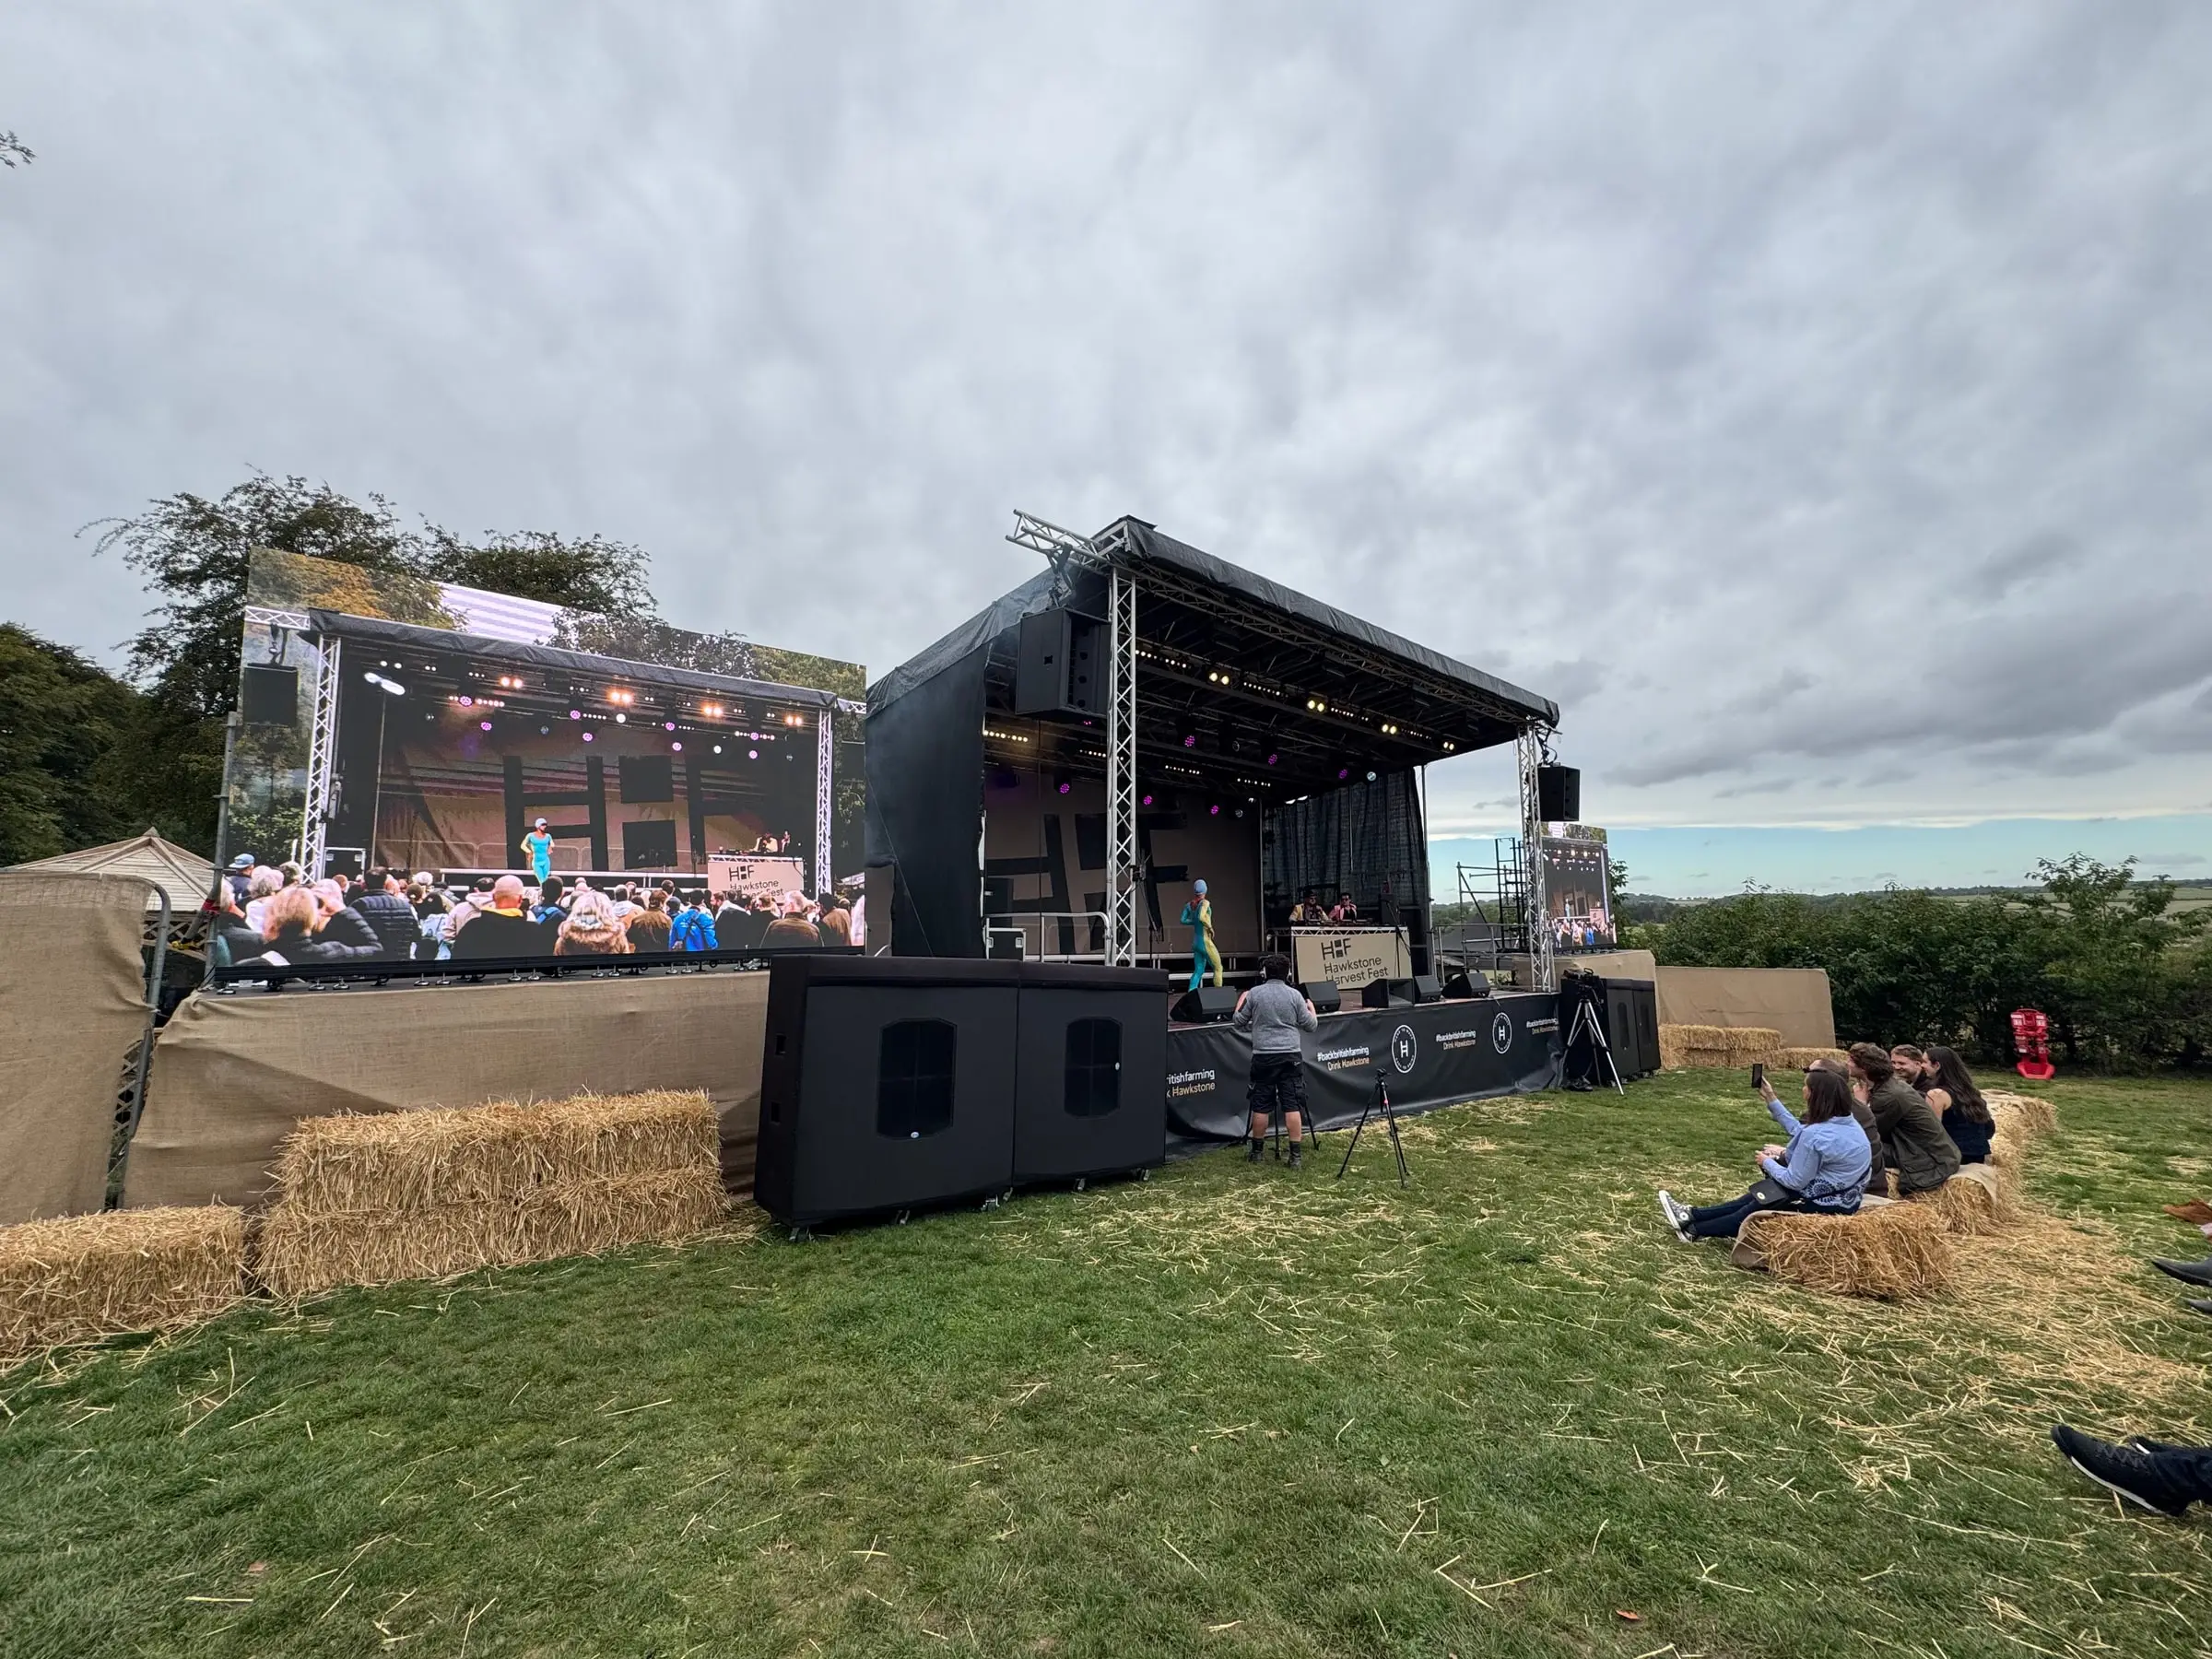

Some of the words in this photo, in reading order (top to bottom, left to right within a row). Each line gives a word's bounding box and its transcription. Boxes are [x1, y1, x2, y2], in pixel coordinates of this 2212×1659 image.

[730, 880, 779, 891] Hawkstone
[1324, 957, 1382, 974] Hawkstone
[1368, 966, 1389, 979] Fest
[1317, 1045, 1370, 1062] #backbritishfarming
[1327, 1061, 1342, 1071] Drink
[1342, 1057, 1370, 1068] Hawkstone
[1171, 1082, 1216, 1098] Hawkstone
